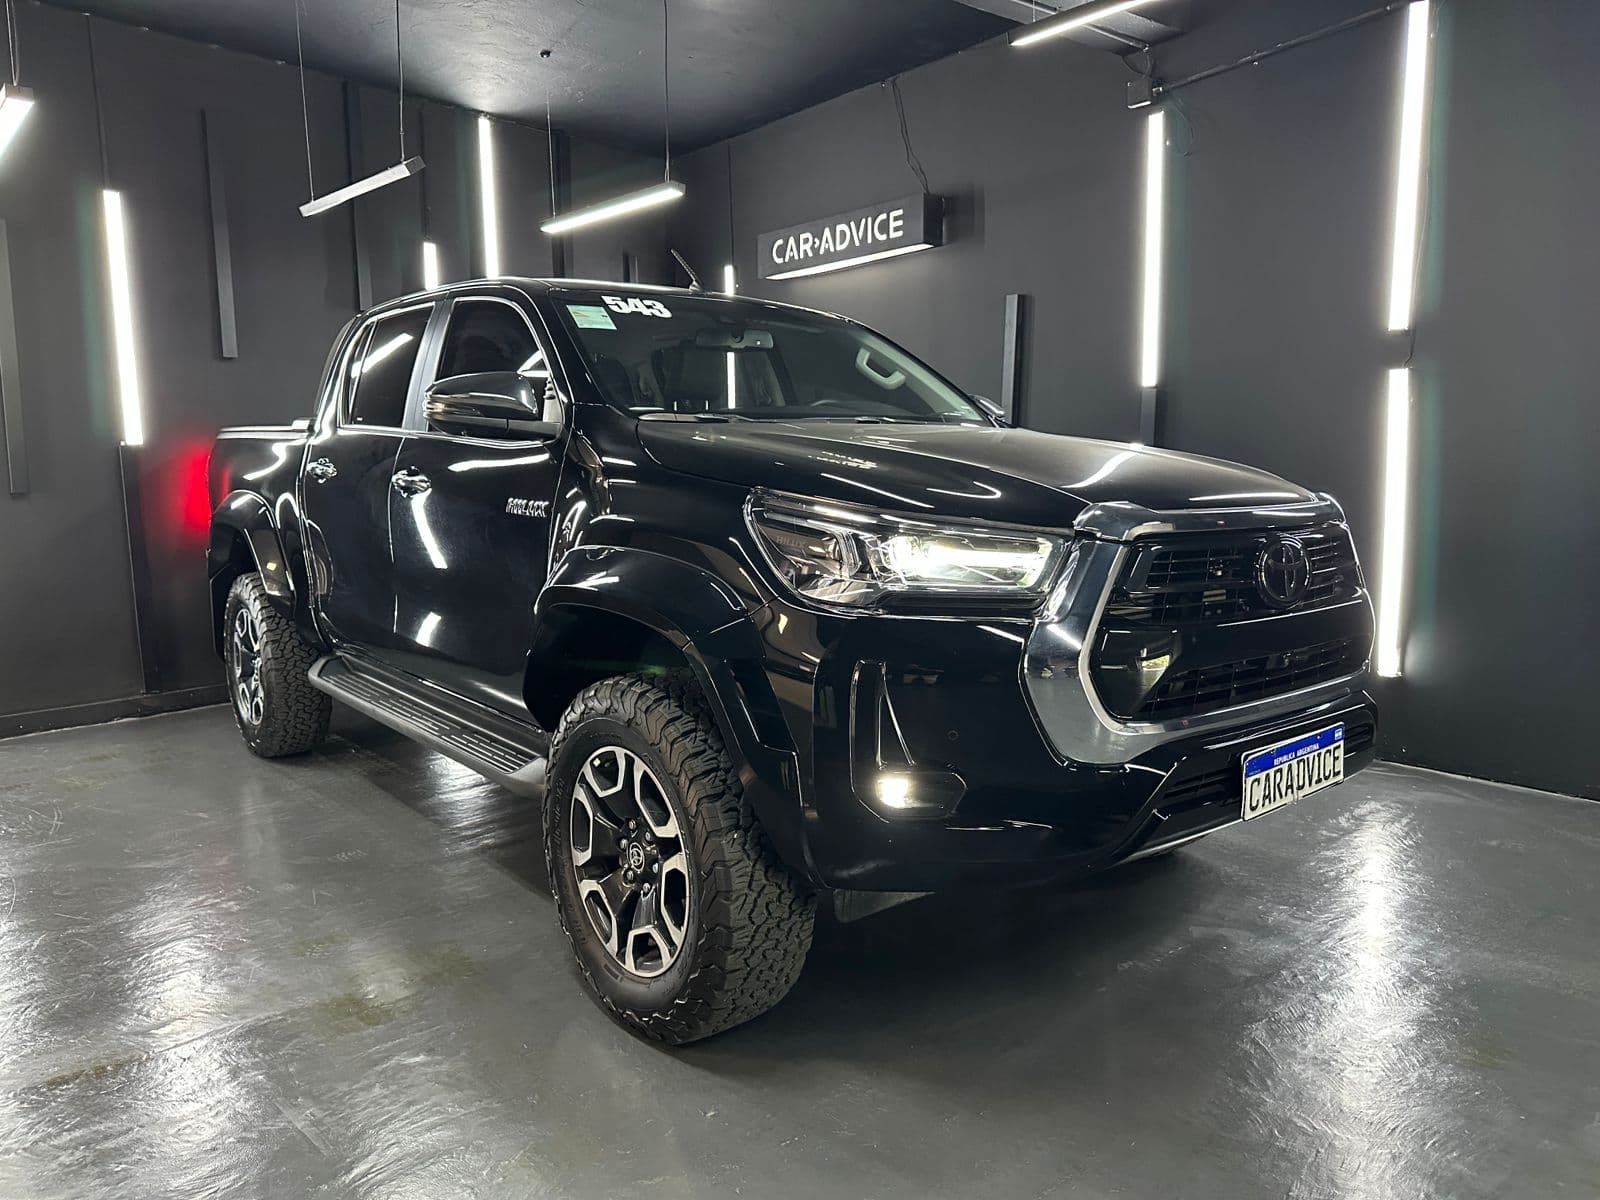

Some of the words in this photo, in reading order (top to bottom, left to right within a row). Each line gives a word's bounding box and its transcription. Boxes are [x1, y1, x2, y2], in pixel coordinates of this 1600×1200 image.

[601, 295, 672, 319] 543
[1296, 743, 1320, 757] ARGENTINA
[1249, 743, 1341, 812] CARADVICE
